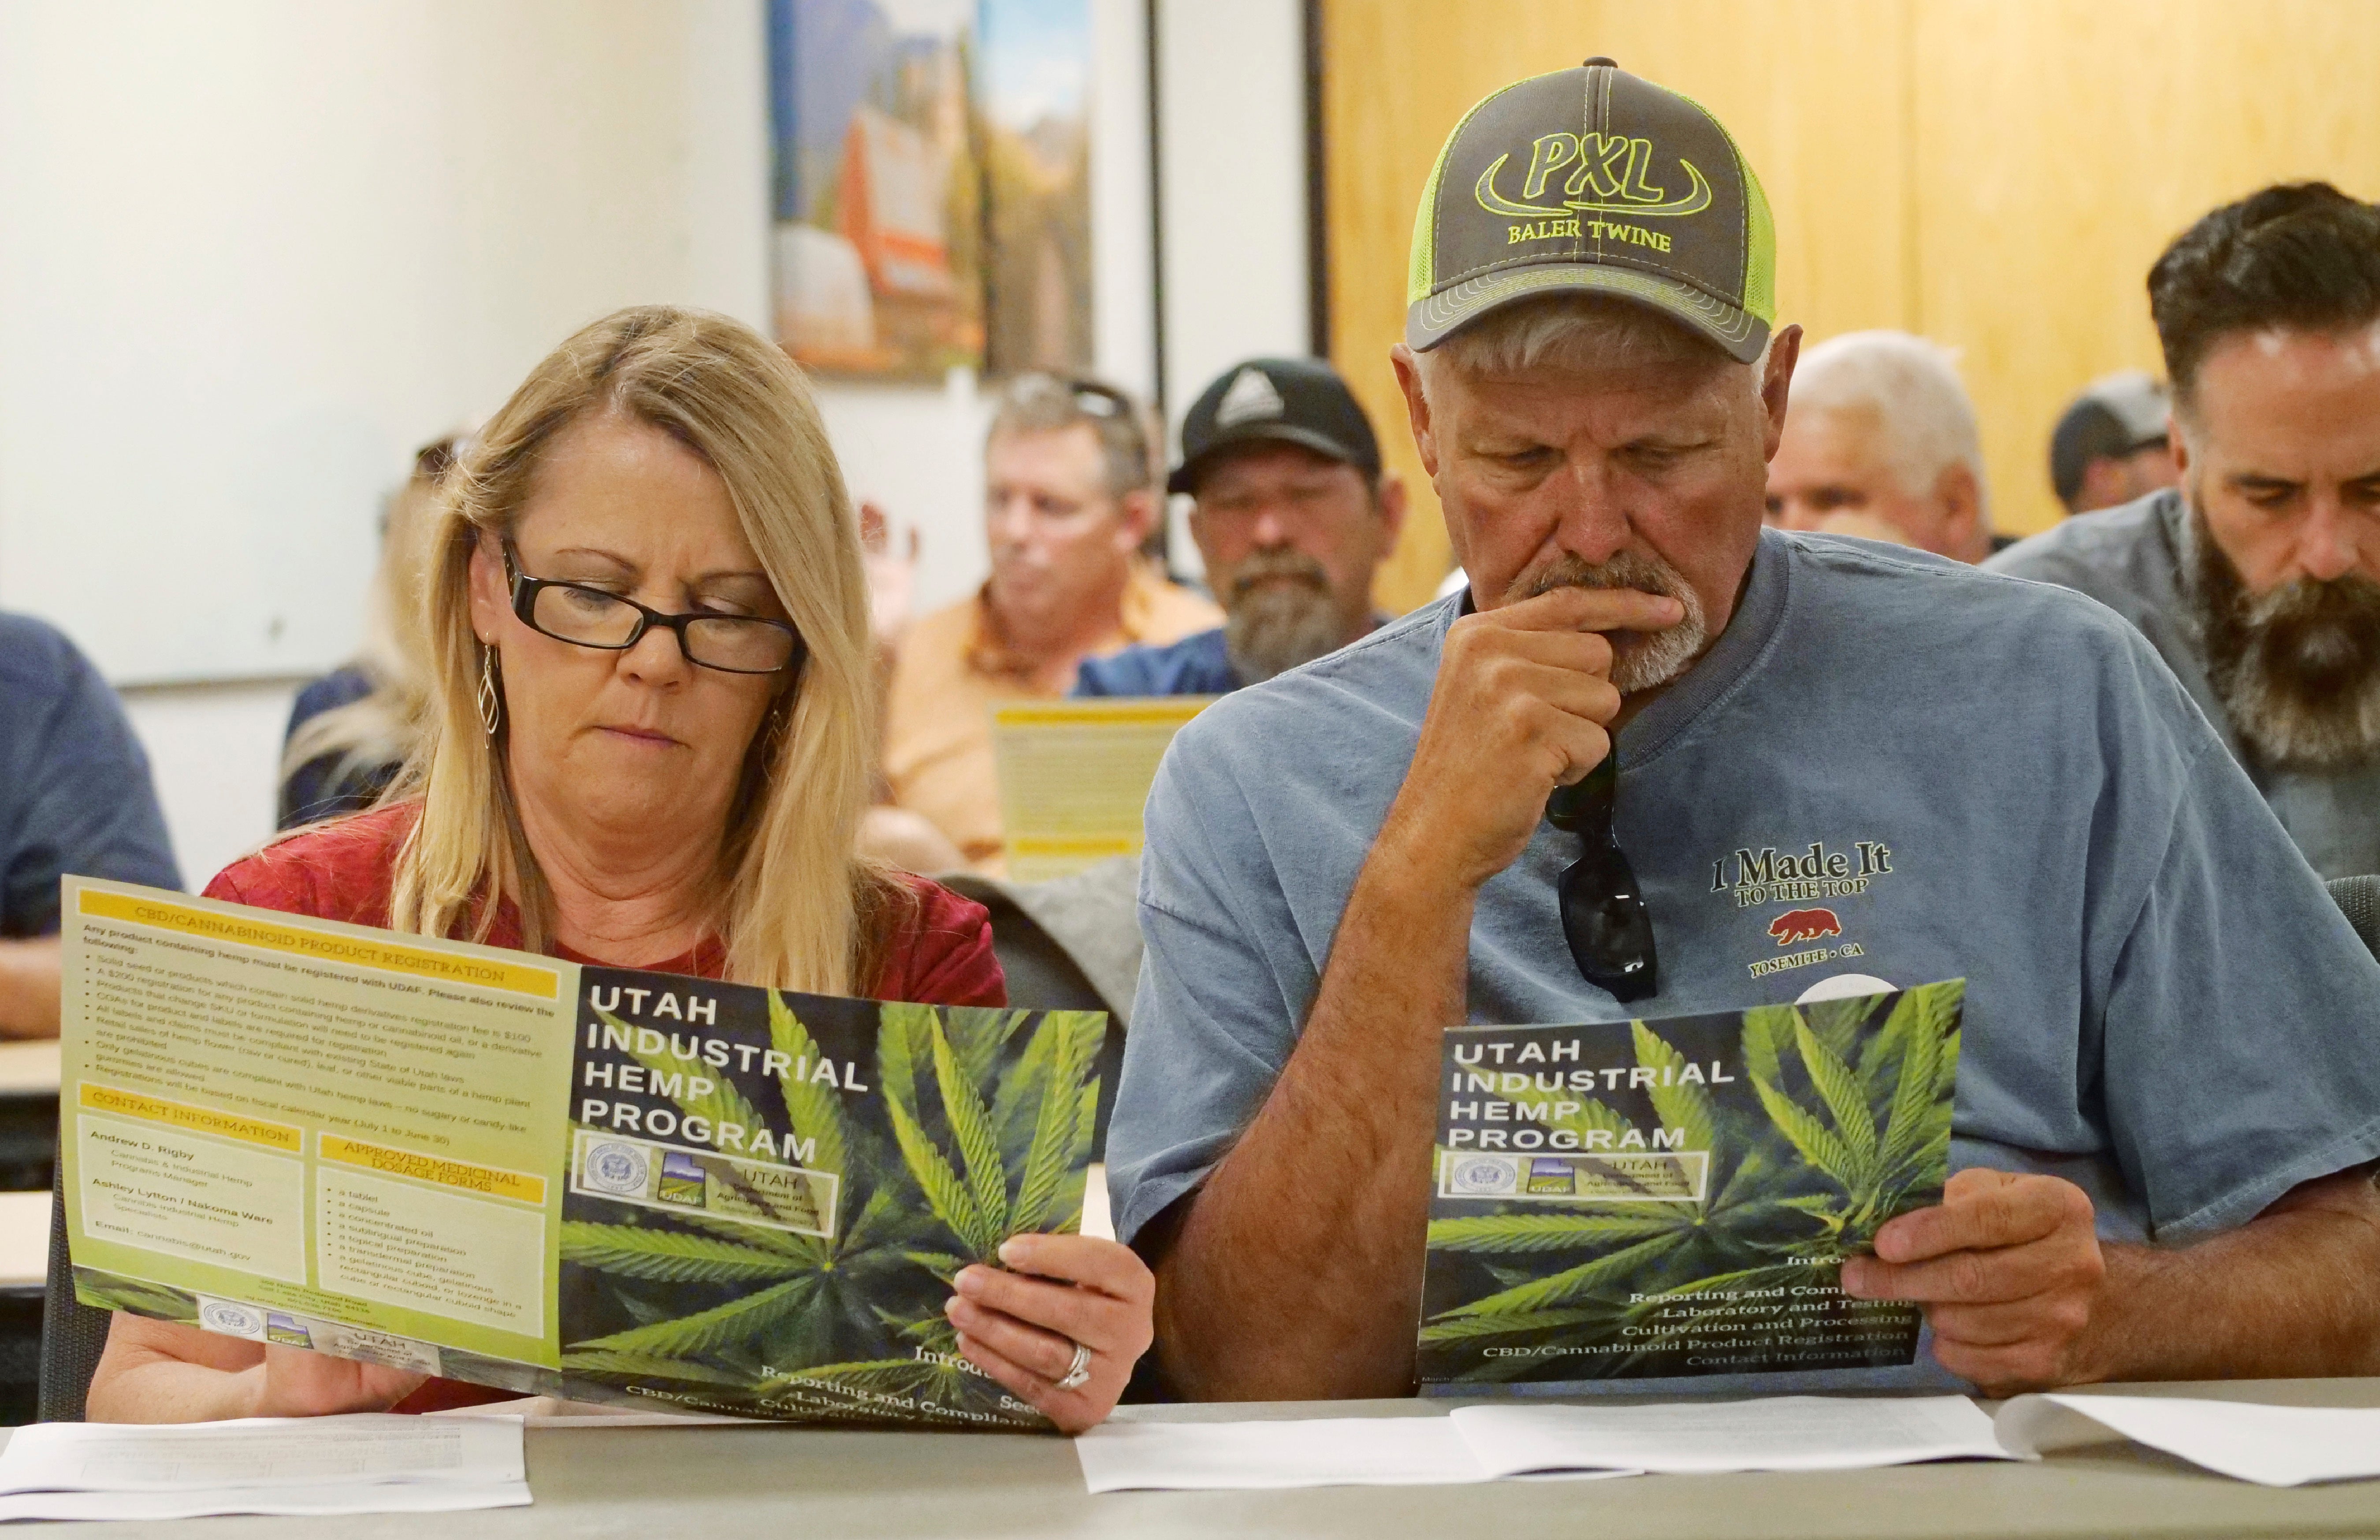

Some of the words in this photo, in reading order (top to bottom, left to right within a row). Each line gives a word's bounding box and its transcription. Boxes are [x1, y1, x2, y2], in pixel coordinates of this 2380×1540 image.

[1523, 132, 1664, 202] PXL
[1508, 219, 1580, 245] BALER
[1587, 220, 1672, 253] TWINE
[1711, 857, 1728, 893] I
[1735, 841, 1850, 888] Made
[1855, 841, 1893, 876] It
[1734, 886, 1767, 907] TO
[1772, 881, 1820, 901] THE
[1822, 878, 1870, 898] TOP
[135, 907, 294, 945] CBD/CANNABINOID
[300, 938, 376, 960] PRODUCT
[382, 952, 504, 981] REGISTRATION
[84, 924, 106, 935] Any
[108, 930, 152, 943] product
[156, 939, 214, 957] containing
[218, 950, 249, 964] hemp
[253, 959, 280, 969] must
[301, 968, 358, 983] registered
[361, 979, 385, 987] with
[389, 983, 423, 994] UDAF.
[428, 988, 466, 1001] Please
[469, 997, 493, 1006] also
[496, 1002, 533, 1013] review
[537, 1007, 554, 1017] the
[1748, 948, 1827, 979] YOSEMITE
[1840, 943, 1864, 957] CA
[97, 955, 123, 966] Solid
[126, 962, 152, 972] seed
[167, 971, 212, 985] products
[216, 981, 246, 991] which
[249, 987, 287, 999] contain
[291, 995, 315, 1005] solid
[318, 999, 347, 1011] hemp
[350, 1006, 407, 1021] derivatives
[410, 1017, 469, 1031] registration
[473, 1025, 489, 1035] fee
[590, 985, 717, 1025] UTAH
[130, 999, 143, 1007] for
[147, 1004, 186, 1016] product
[190, 1013, 208, 1021] and
[212, 1016, 242, 1028] labels
[265, 1029, 309, 1041] required
[312, 1036, 324, 1045] for
[329, 1041, 386, 1057] registration
[137, 977, 194, 993] registration
[198, 988, 210, 996] for
[214, 993, 234, 1002] any
[237, 997, 275, 1009] product
[279, 1006, 332, 1022] containing
[335, 1015, 365, 1028] hemp
[383, 1025, 446, 1041] cannabinoid
[491, 1043, 542, 1058] derivative
[112, 1007, 142, 1020] labels
[146, 1016, 165, 1024] and
[168, 1020, 201, 1032] claims
[204, 1028, 229, 1037] must
[249, 1038, 298, 1052] compliant
[325, 1053, 365, 1067] existing
[370, 1060, 396, 1071] State
[413, 1068, 437, 1078] Utah
[586, 1023, 868, 1093] INDUSTRIAL
[1453, 1039, 1580, 1065] UTAH
[584, 1061, 714, 1102] HEMP
[1452, 1060, 1736, 1094] INDUSTRIAL
[93, 1092, 168, 1115] CONTACT
[174, 1109, 289, 1142] INFORMATION
[1450, 1100, 1580, 1121] HEMP
[91, 1131, 138, 1147] Andrew
[158, 1146, 193, 1161] Rigby
[581, 1099, 816, 1163] PROGRAM
[1447, 1128, 1686, 1150] PROGRAM
[344, 1142, 428, 1166] APPROVED
[432, 1160, 519, 1186] MEDICINAL
[372, 1158, 433, 1180] DOSAGE
[438, 1172, 491, 1191] FORMS
[744, 1169, 797, 1189] UTAH
[1613, 1160, 1667, 1170] UTAH
[93, 1178, 134, 1194] Ashley
[349, 1191, 377, 1202] tablet
[348, 1203, 390, 1217] capsule
[348, 1215, 417, 1234] concentrated
[349, 1225, 402, 1241] sublingual
[405, 1239, 466, 1255] preparation
[349, 1236, 383, 1247] topical
[387, 1245, 446, 1262] preparation
[349, 1246, 411, 1264] transdermal
[415, 1262, 475, 1278] preparation
[1630, 1290, 1738, 1304] Reporting
[1744, 1287, 1785, 1298] and
[1663, 1305, 1784, 1317] Laboratory
[1789, 1301, 1830, 1312] and
[354, 1332, 405, 1349] UTAH
[1622, 1322, 1746, 1336] Cultivation
[1752, 1318, 1793, 1330] and
[1800, 1314, 1912, 1328] Processing
[1483, 1341, 1680, 1358] CBD/Cannabinoid
[1687, 1337, 1772, 1350] Product
[1778, 1331, 1908, 1345] Registration
[1686, 1353, 1767, 1366] Contact
[1776, 1347, 1906, 1362] Information
[762, 1365, 868, 1401] Reporting
[875, 1393, 914, 1409] and
